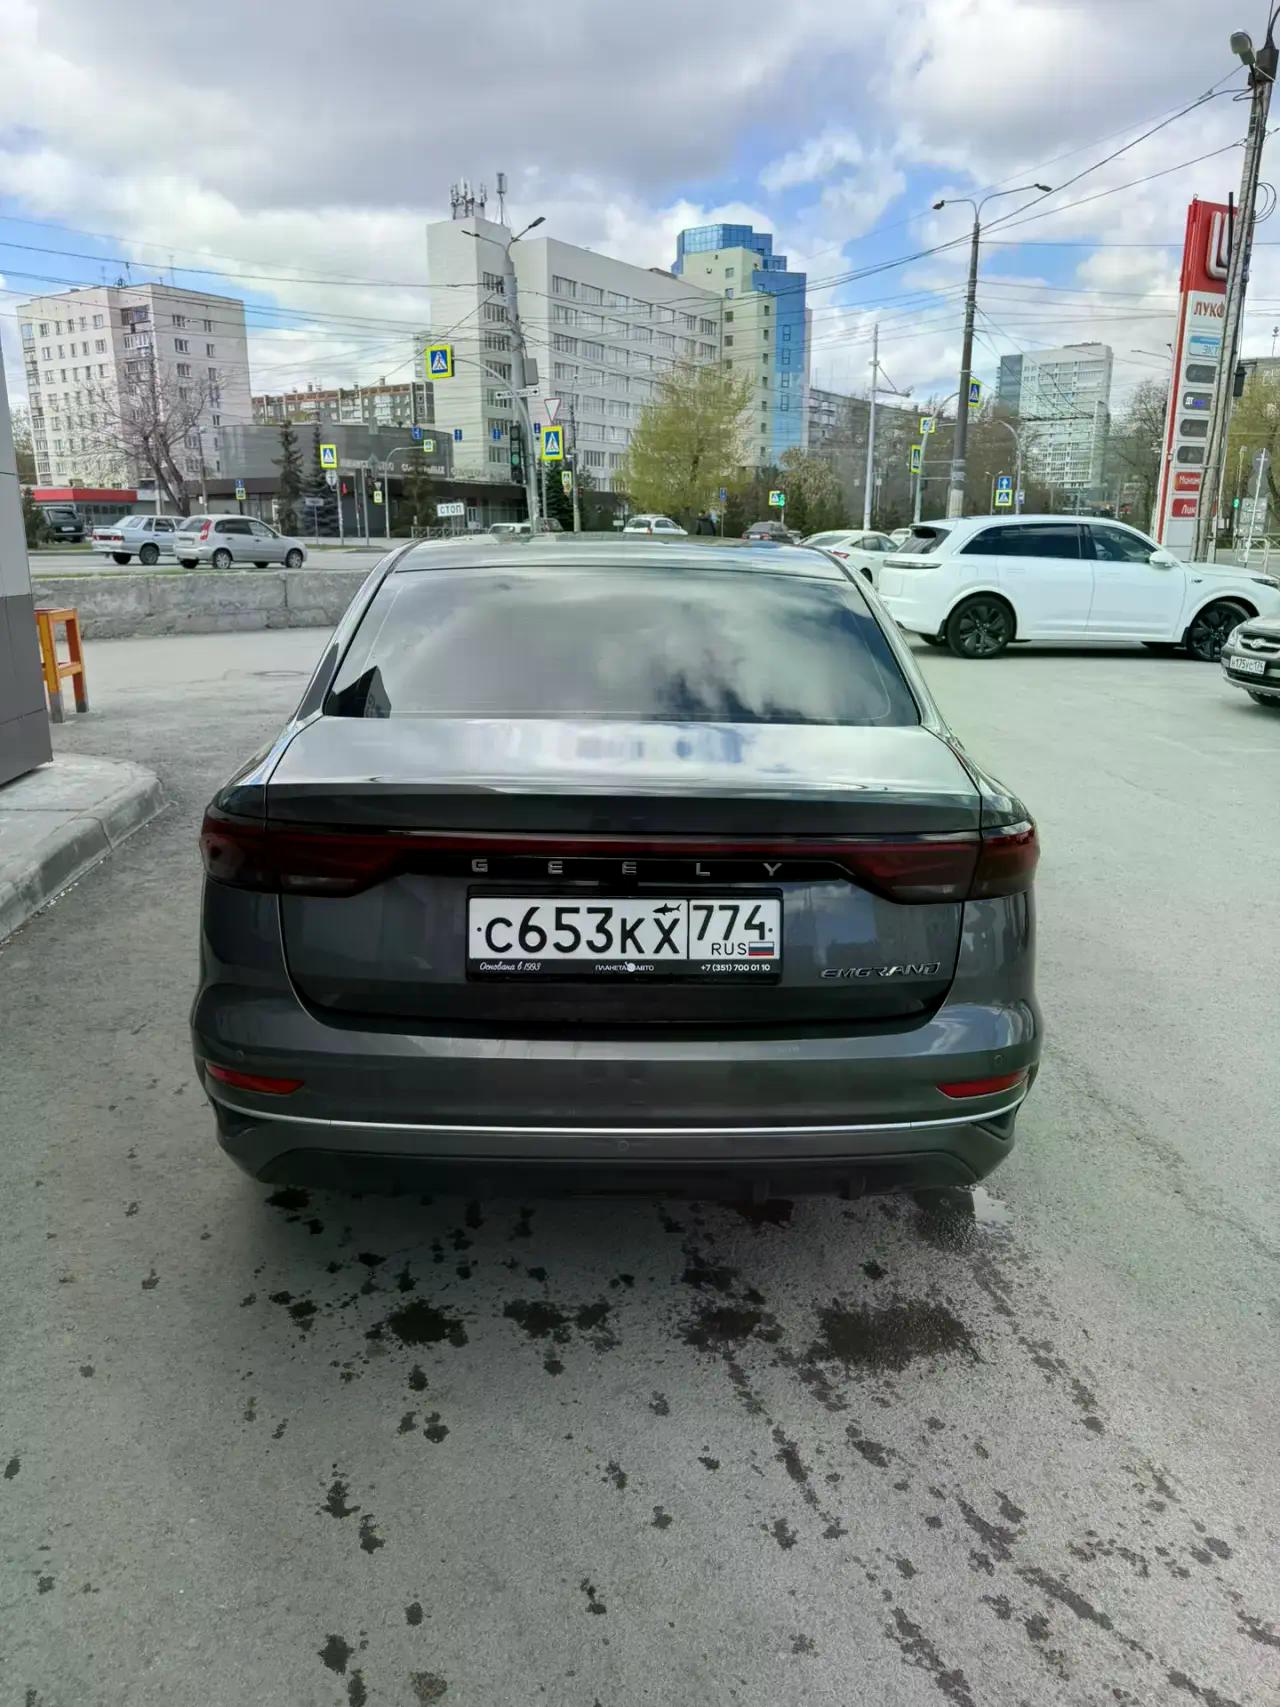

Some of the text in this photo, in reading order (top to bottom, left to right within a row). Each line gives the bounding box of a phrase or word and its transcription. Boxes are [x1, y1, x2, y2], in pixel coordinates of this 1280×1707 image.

[439, 505, 462, 515] СТОП
[471, 858, 783, 877] GEELY
[692, 904, 766, 941] 774
[711, 942, 748, 956] RUS
[701, 963, 771, 972] +7 (351) 700 01 10
[820, 962, 941, 979] EMGRAND
